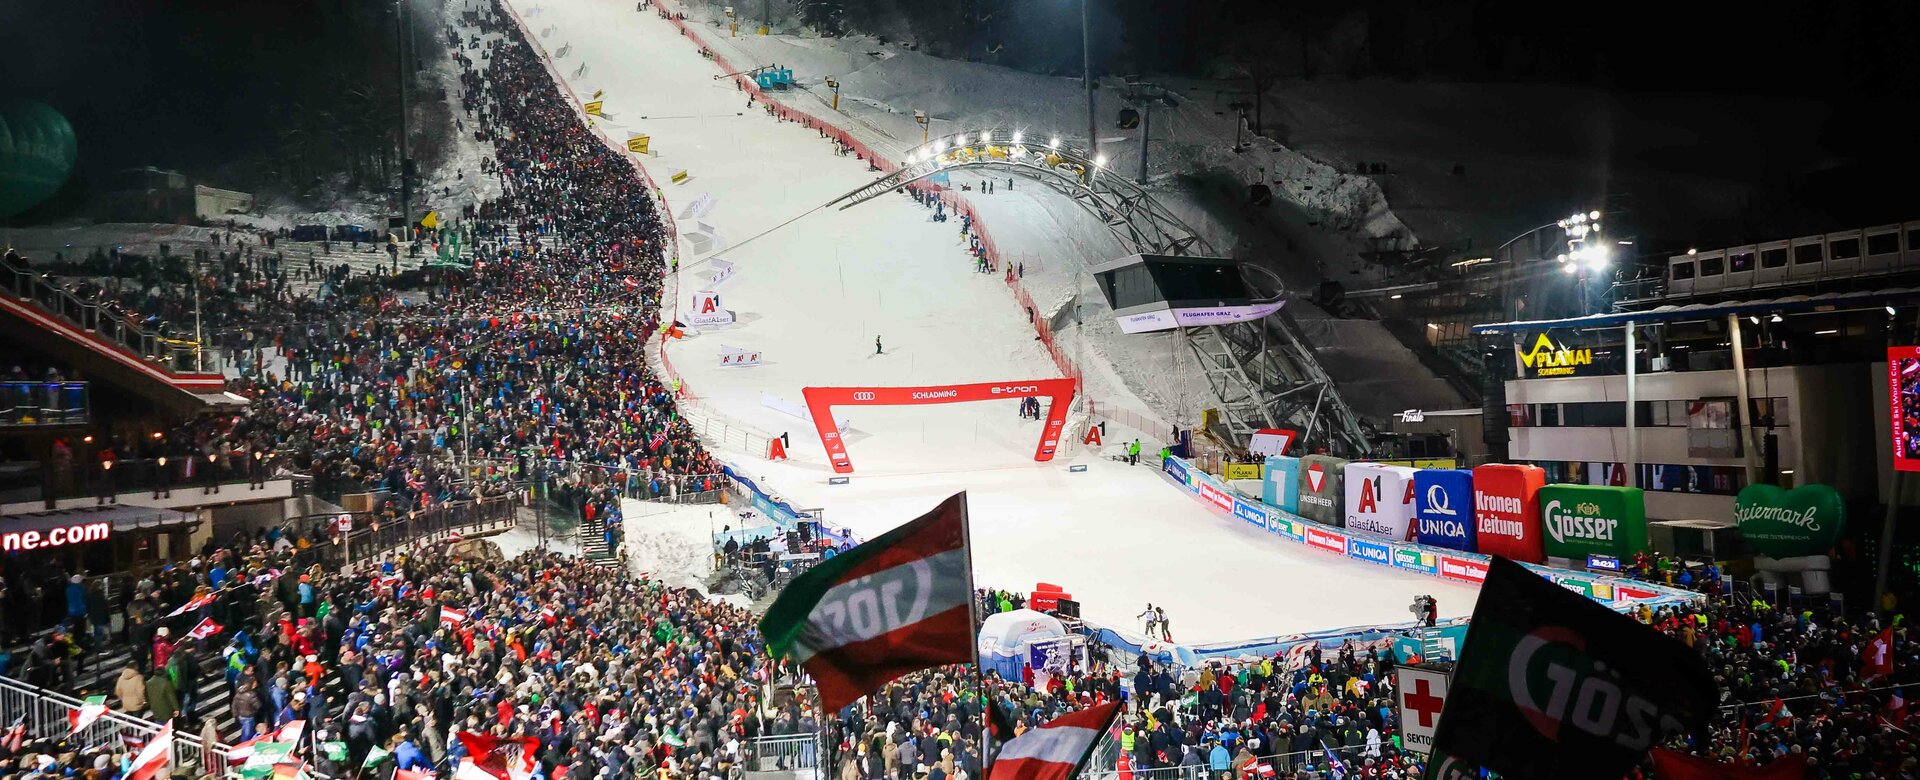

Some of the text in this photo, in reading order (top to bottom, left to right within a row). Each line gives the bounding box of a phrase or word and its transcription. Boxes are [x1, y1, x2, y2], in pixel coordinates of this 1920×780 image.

[701, 294, 719, 314] A1
[1536, 348, 1592, 368] PLANAI
[912, 390, 957, 400] SCHLADMING
[991, 385, 1038, 394] e-tron
[1083, 421, 1106, 447] A1
[769, 431, 789, 461] A1
[1300, 494, 1332, 507] UNSER HEER
[1358, 474, 1381, 513] A1
[1475, 490, 1522, 514] Kronen
[1244, 508, 1264, 526] UNIQA
[1348, 515, 1393, 535] GlasfA1ser
[1477, 513, 1524, 540] Zeitung
[1545, 500, 1618, 543] Gösser
[1734, 502, 1821, 531] Steiermark
[1419, 519, 1466, 538] UNIQA
[1308, 531, 1344, 551] Kronen Zeitung
[1362, 546, 1388, 561] UNIQA
[1394, 547, 1416, 564] Gösser
[1443, 561, 1465, 576] Kronen
[1406, 732, 1434, 746] SEKTO
